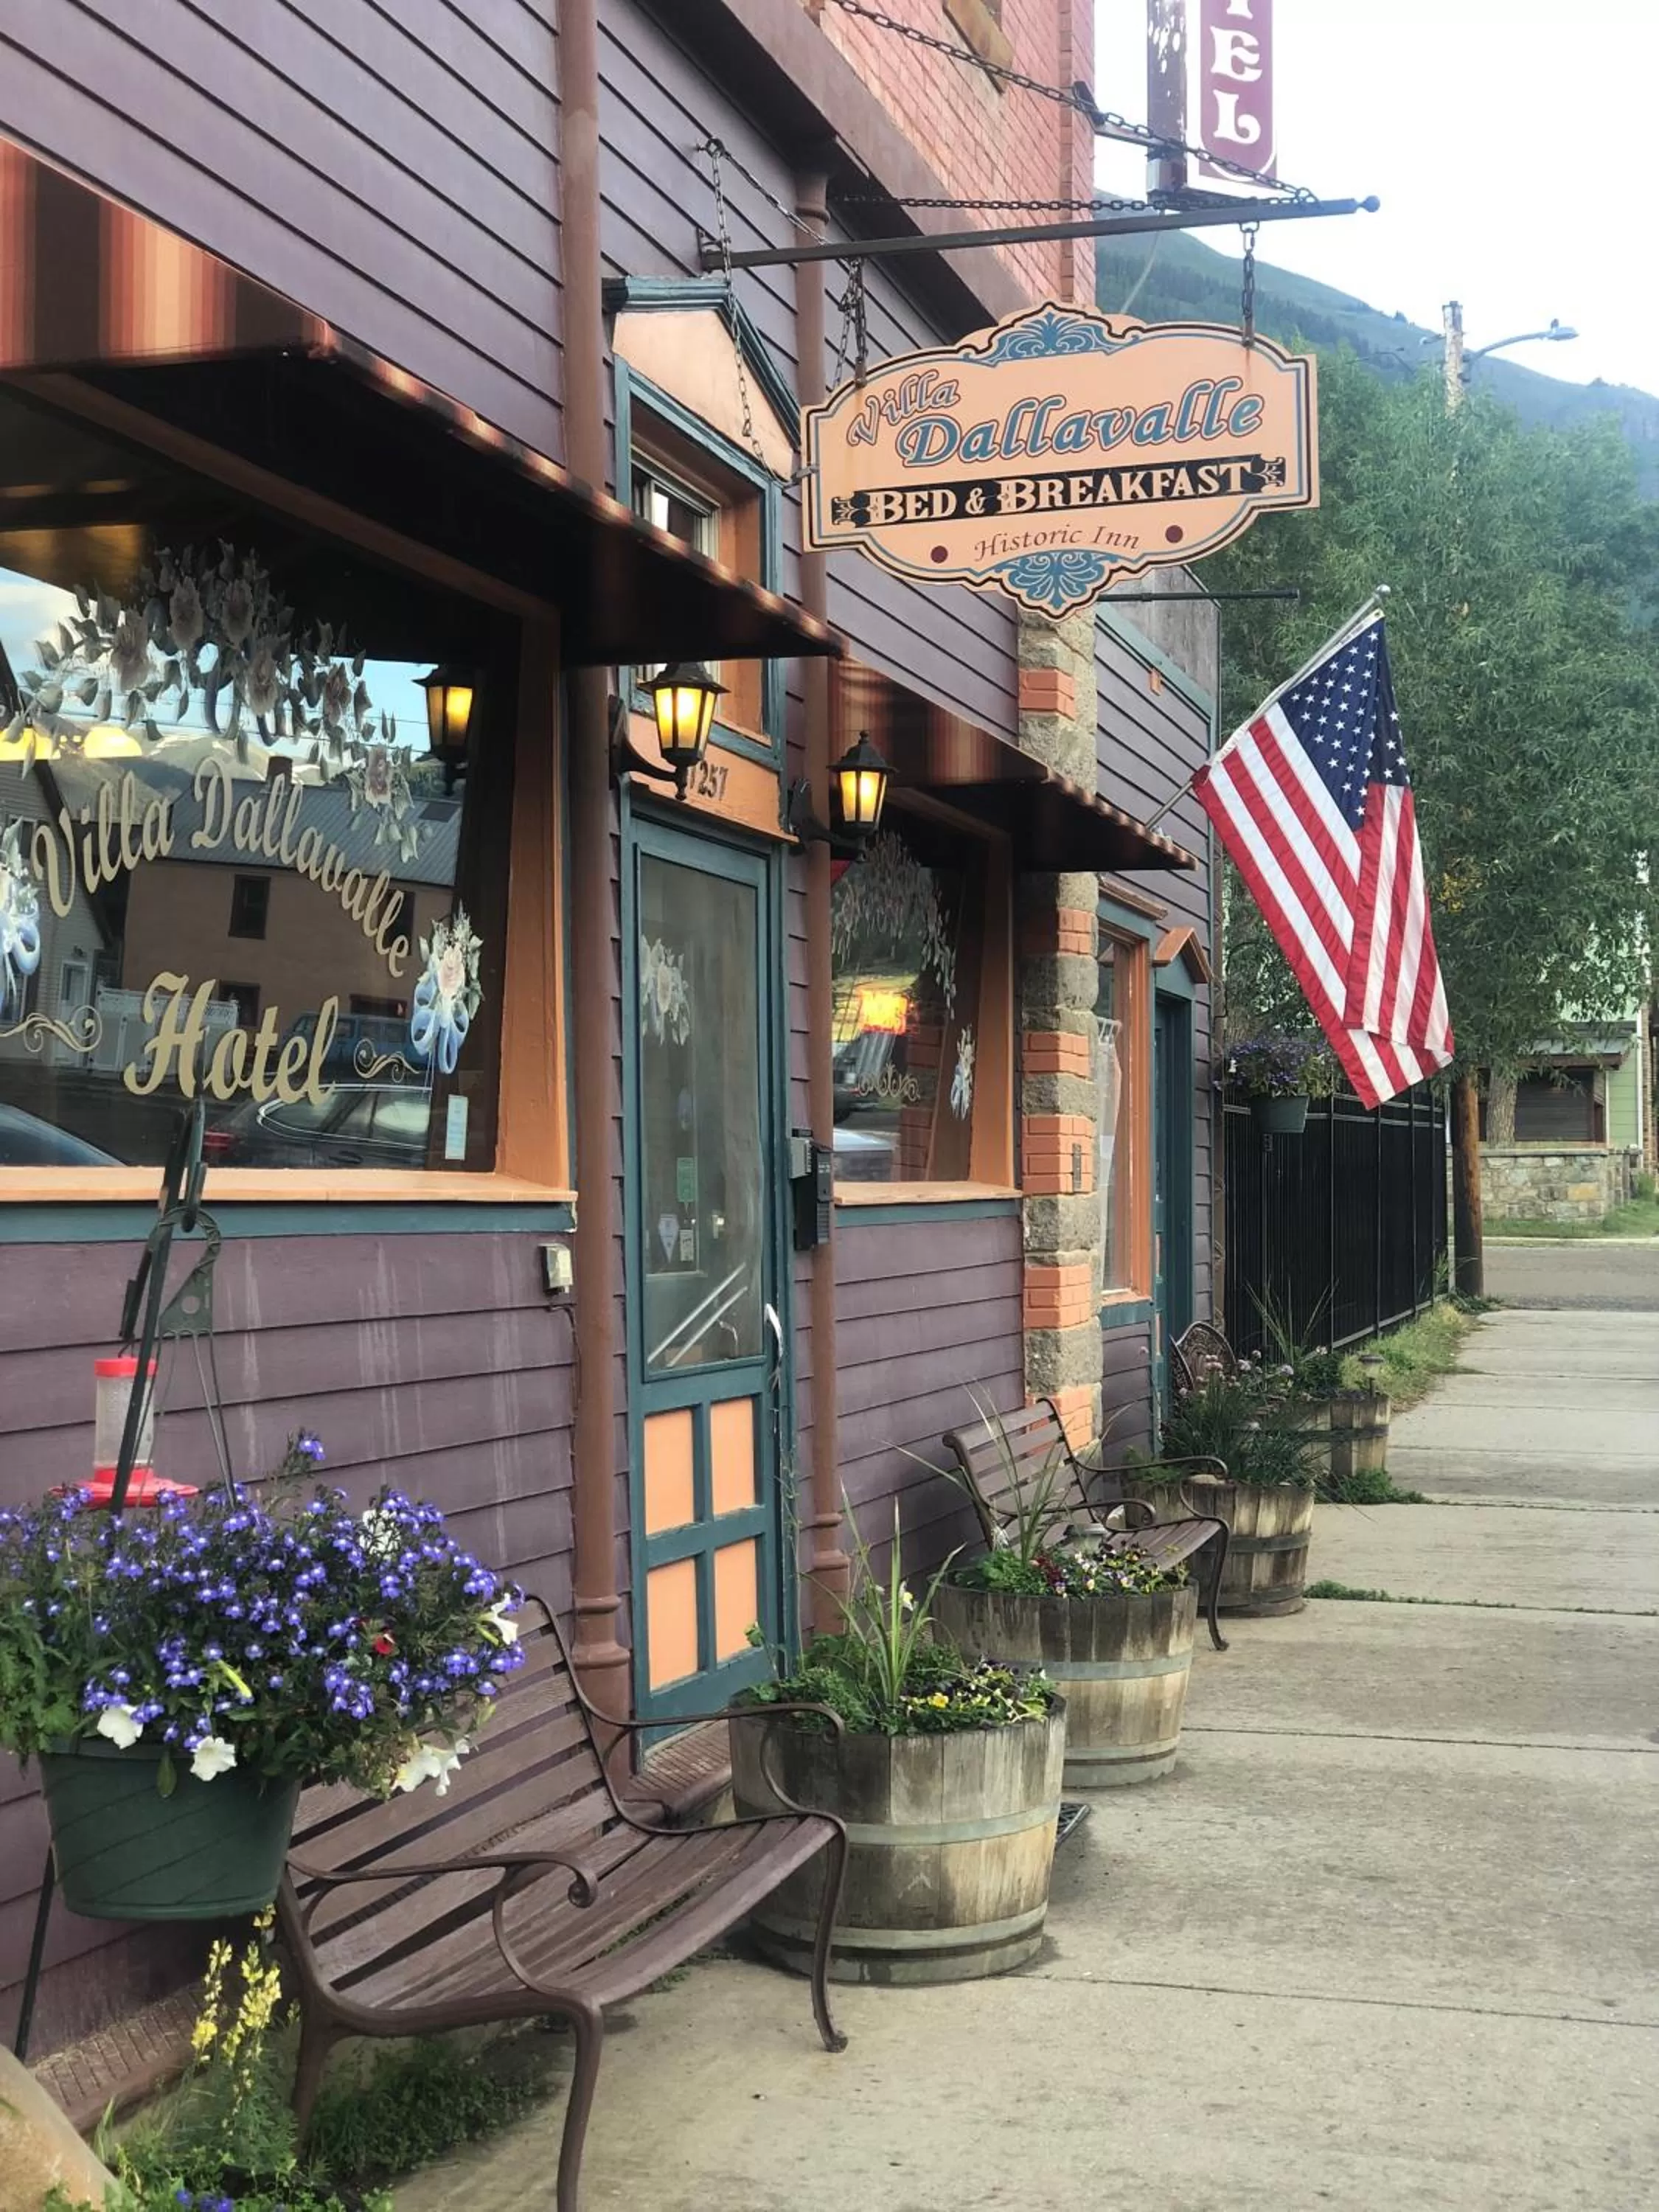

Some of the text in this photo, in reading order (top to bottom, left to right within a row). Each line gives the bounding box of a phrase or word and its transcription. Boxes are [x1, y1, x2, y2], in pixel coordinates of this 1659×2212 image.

[846, 369, 961, 447] Villa
[895, 375, 1265, 467] Dallavalle
[866, 461, 1251, 526] BED & BREAKFAST
[974, 523, 1140, 561] Historic Inn
[30, 755, 411, 978] Villa Dallavalle
[123, 970, 338, 1106] Hotel
